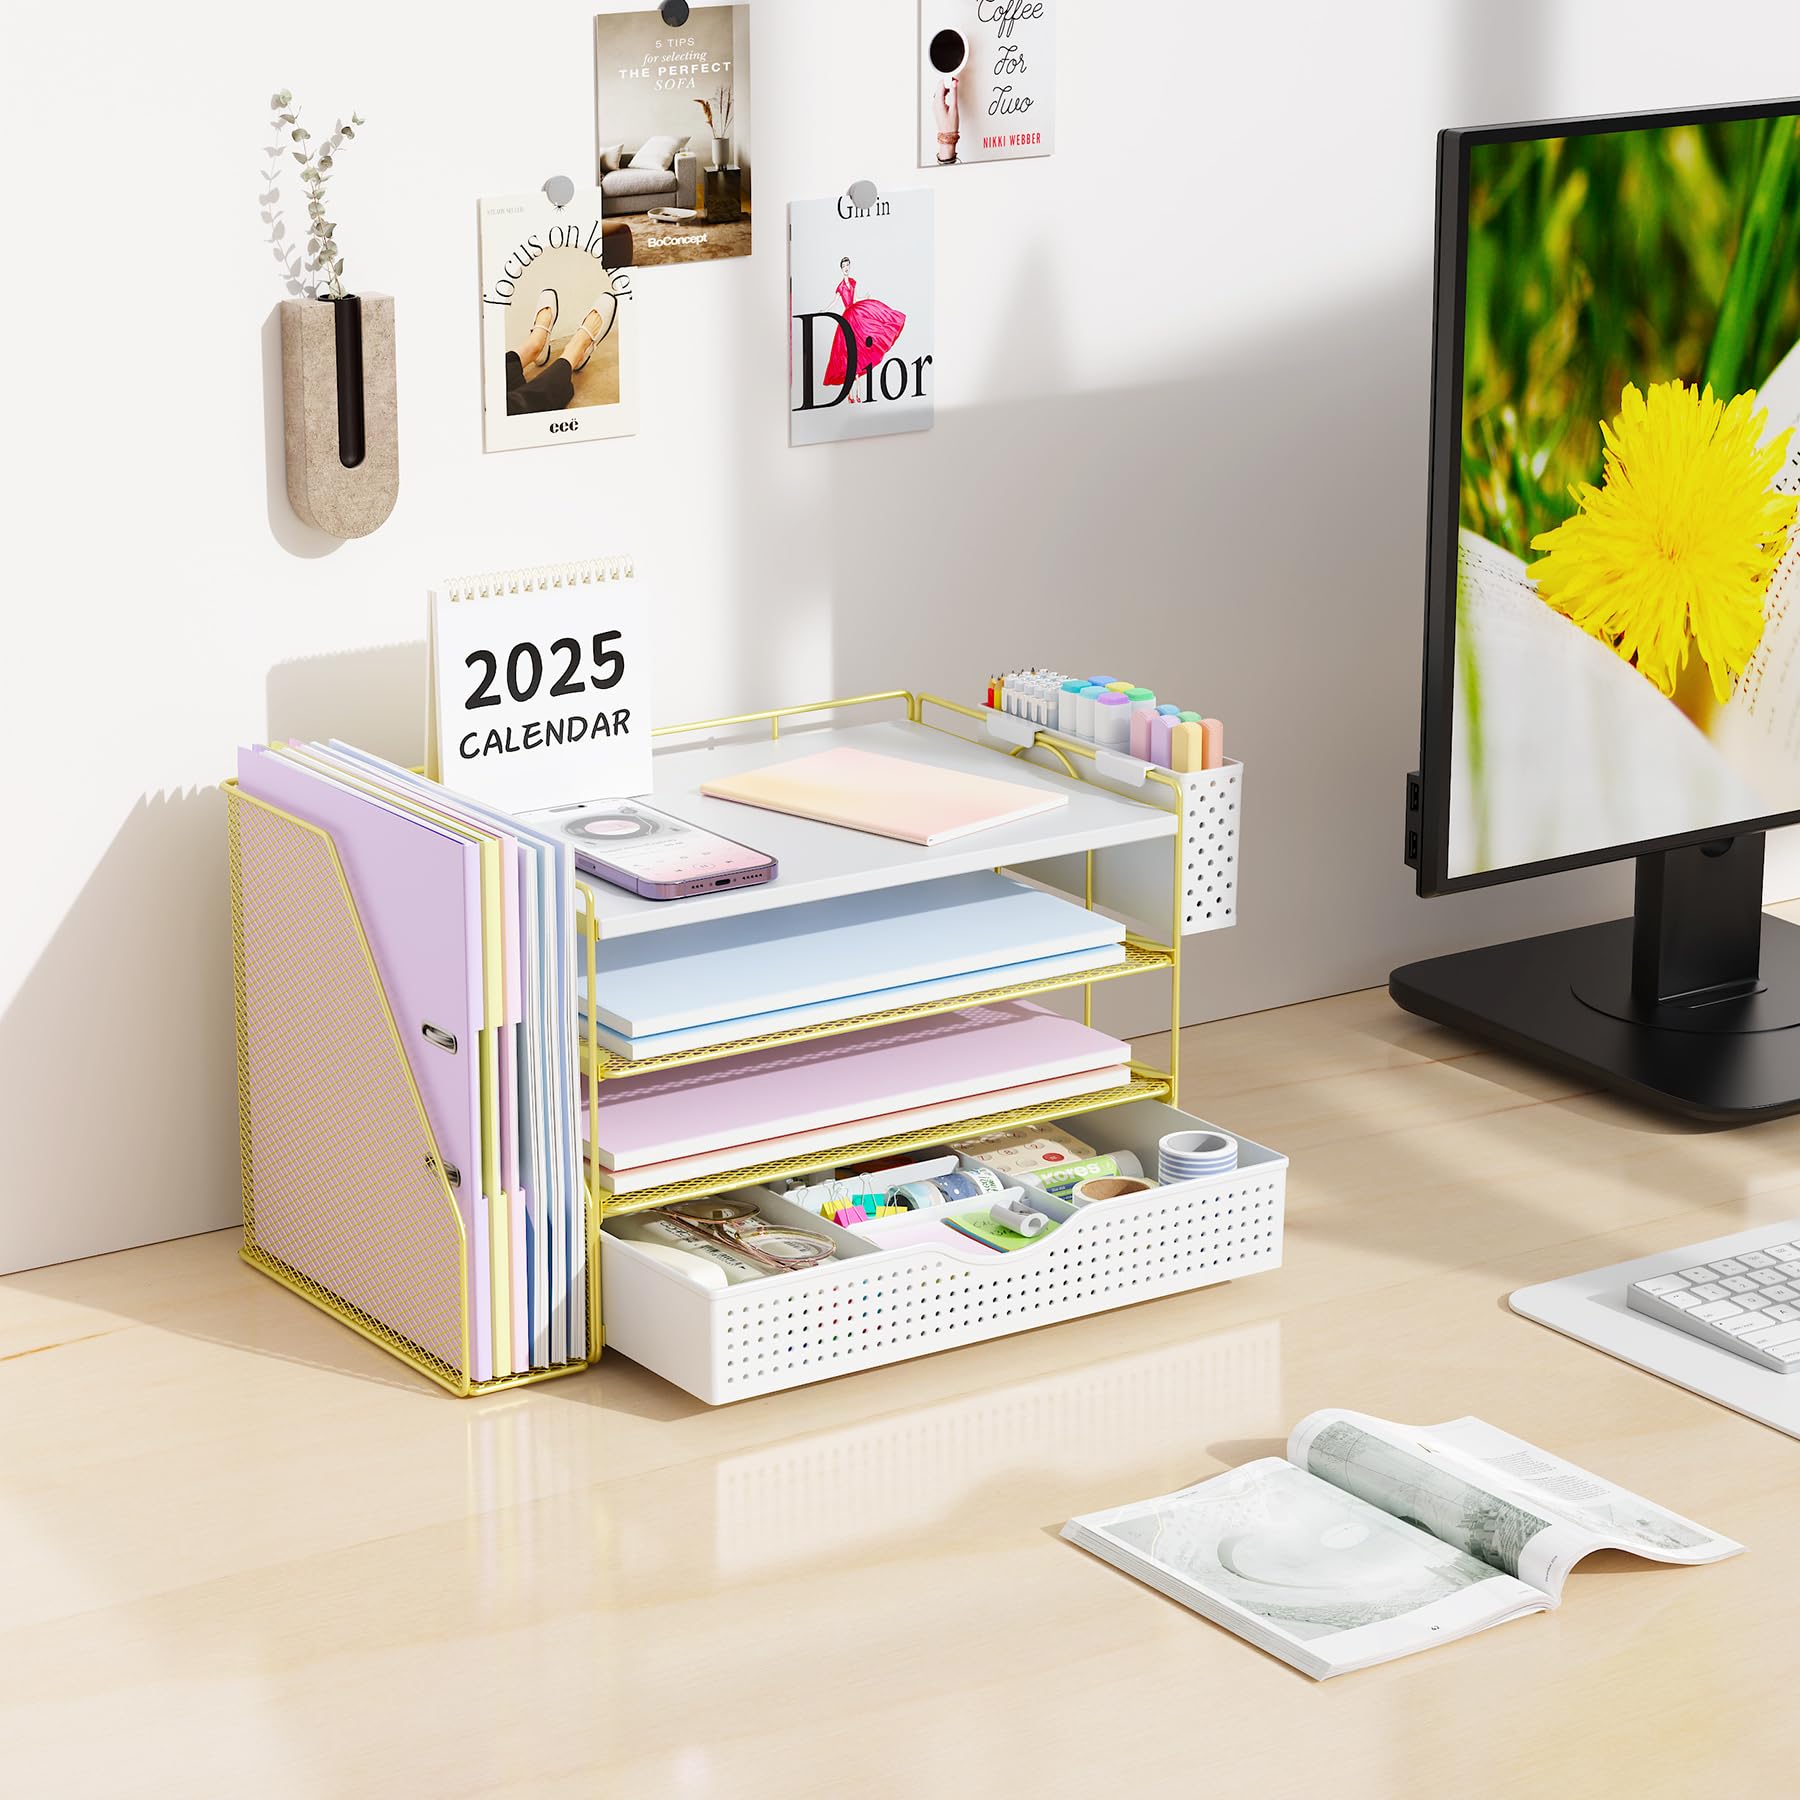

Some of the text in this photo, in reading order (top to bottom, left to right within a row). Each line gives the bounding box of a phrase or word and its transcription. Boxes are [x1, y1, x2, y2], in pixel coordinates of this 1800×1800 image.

[977, 0, 1044, 39] Coffee
[655, 37, 695, 49] 5 TIPS
[642, 50, 708, 67] for selecting
[993, 45, 1027, 76] For
[618, 61, 732, 79] THE PERFECT
[654, 77, 696, 91] SOFA
[988, 85, 1034, 116] Two
[983, 132, 1041, 149] NIKKI WEBBER
[876, 196, 891, 216] in
[548, 224, 580, 250] on
[647, 232, 708, 248] BoConcept
[792, 310, 933, 412] Dior
[464, 630, 625, 710] 2025
[459, 708, 631, 760] CALENDAR
[1041, 1162, 1101, 1184] Kores
